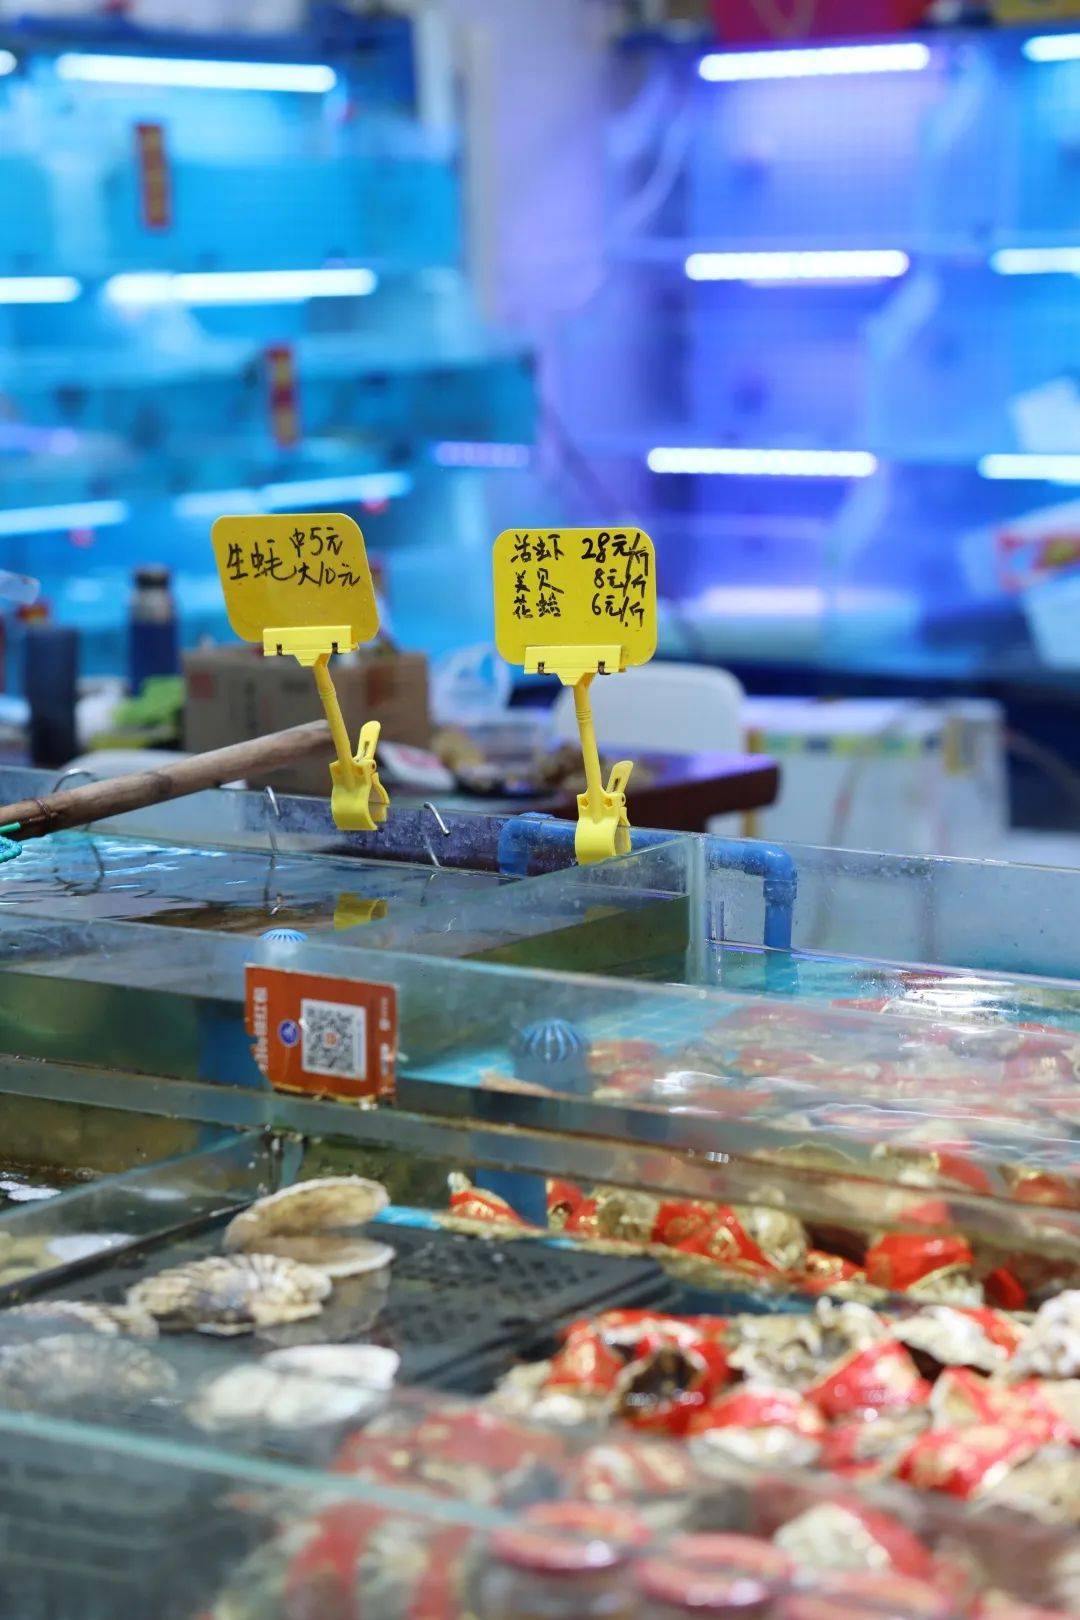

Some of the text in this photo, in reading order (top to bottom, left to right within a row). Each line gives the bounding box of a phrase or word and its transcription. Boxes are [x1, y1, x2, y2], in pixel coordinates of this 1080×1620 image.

[226, 539, 297, 581] 生蚝
[510, 533, 565, 564] 活虾
[513, 593, 563, 620] 花蛤
